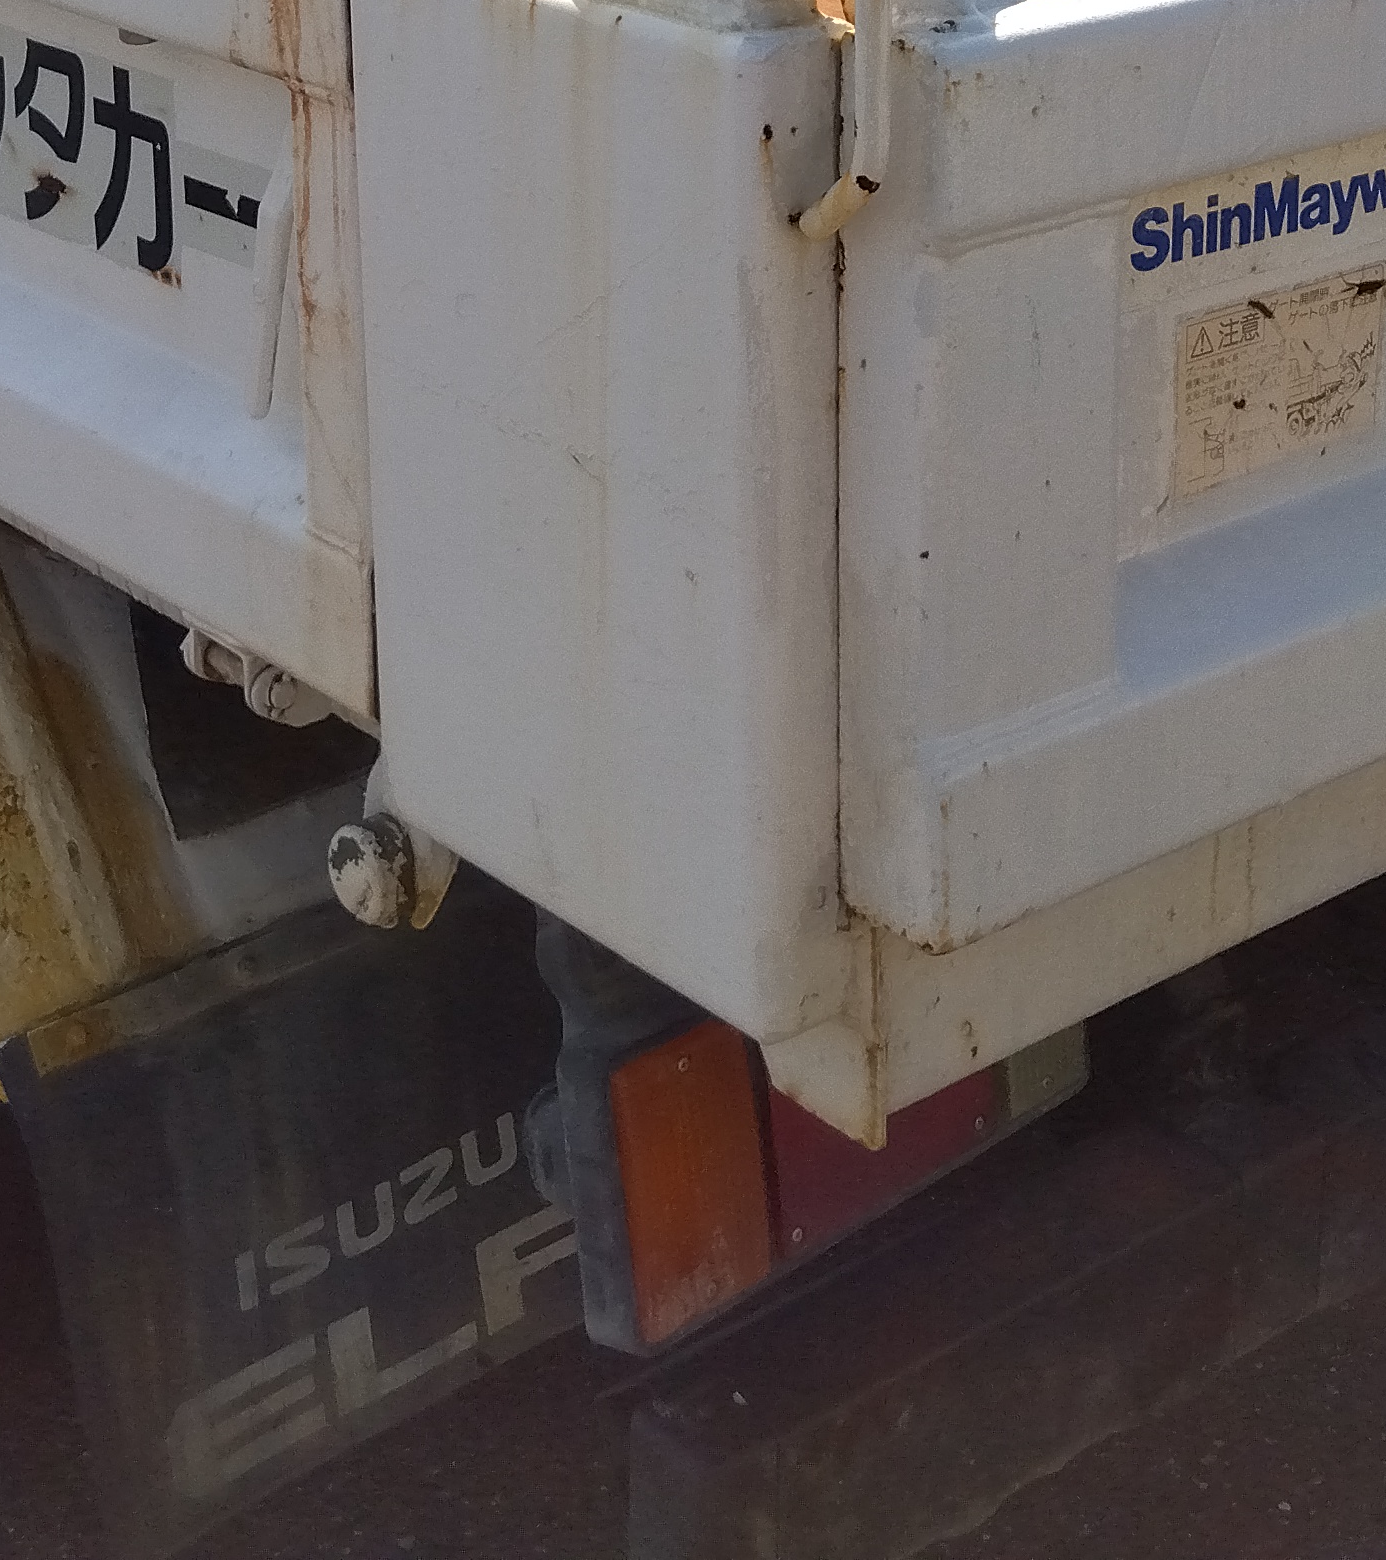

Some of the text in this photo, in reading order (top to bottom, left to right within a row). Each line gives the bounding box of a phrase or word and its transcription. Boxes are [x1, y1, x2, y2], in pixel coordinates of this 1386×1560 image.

[1217, 312, 1260, 351] 注意
[233, 1111, 519, 1312] ISUZU
[165, 1203, 579, 1500] ELF
